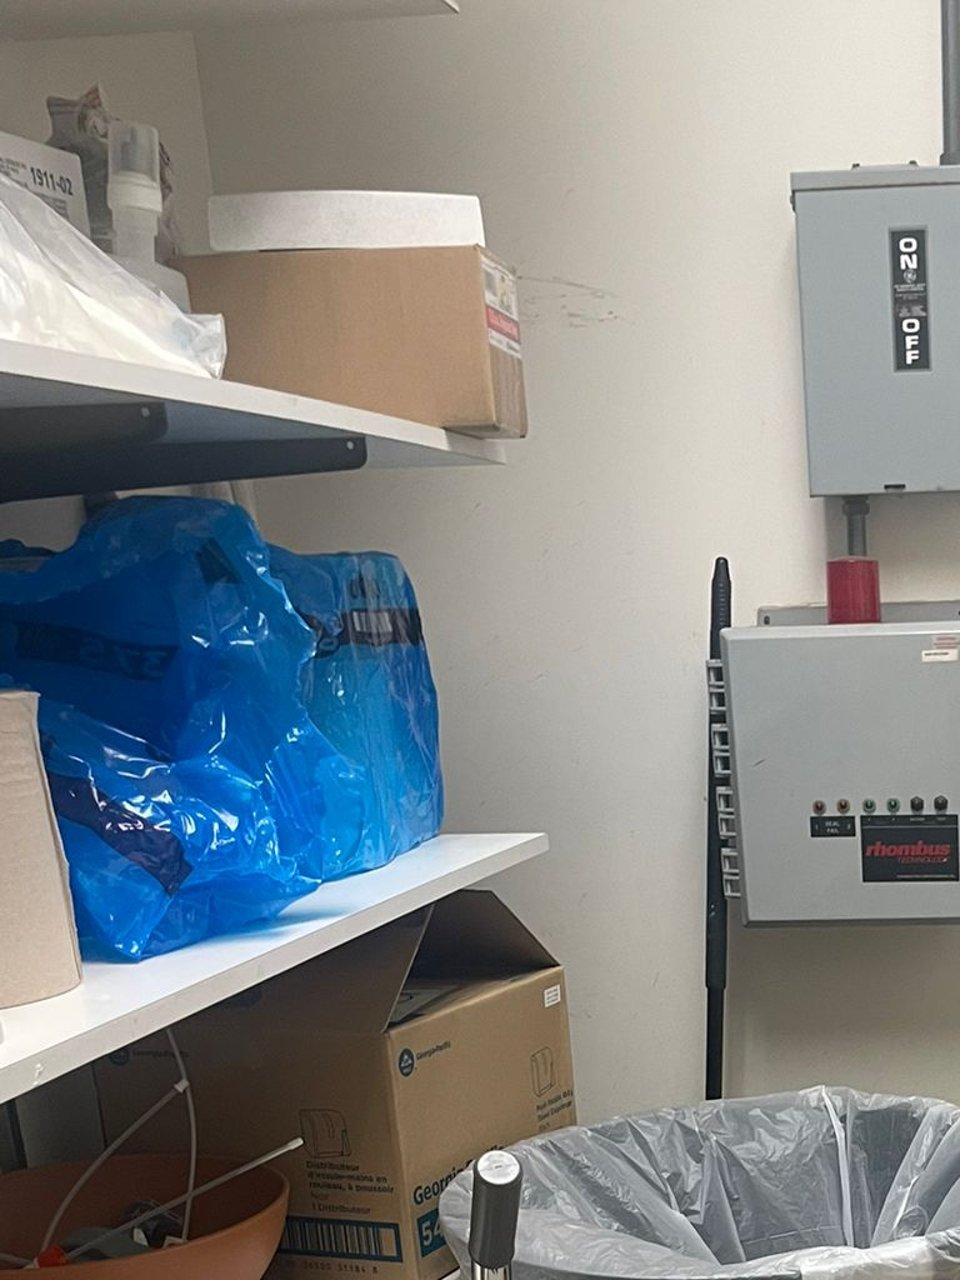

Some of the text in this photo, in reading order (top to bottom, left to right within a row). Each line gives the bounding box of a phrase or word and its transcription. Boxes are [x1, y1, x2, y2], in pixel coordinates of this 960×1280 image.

[30, 166, 74, 196] 1911-02
[899, 237, 918, 270] ON
[902, 318, 920, 365] OFF
[864, 840, 951, 857] rhombus
